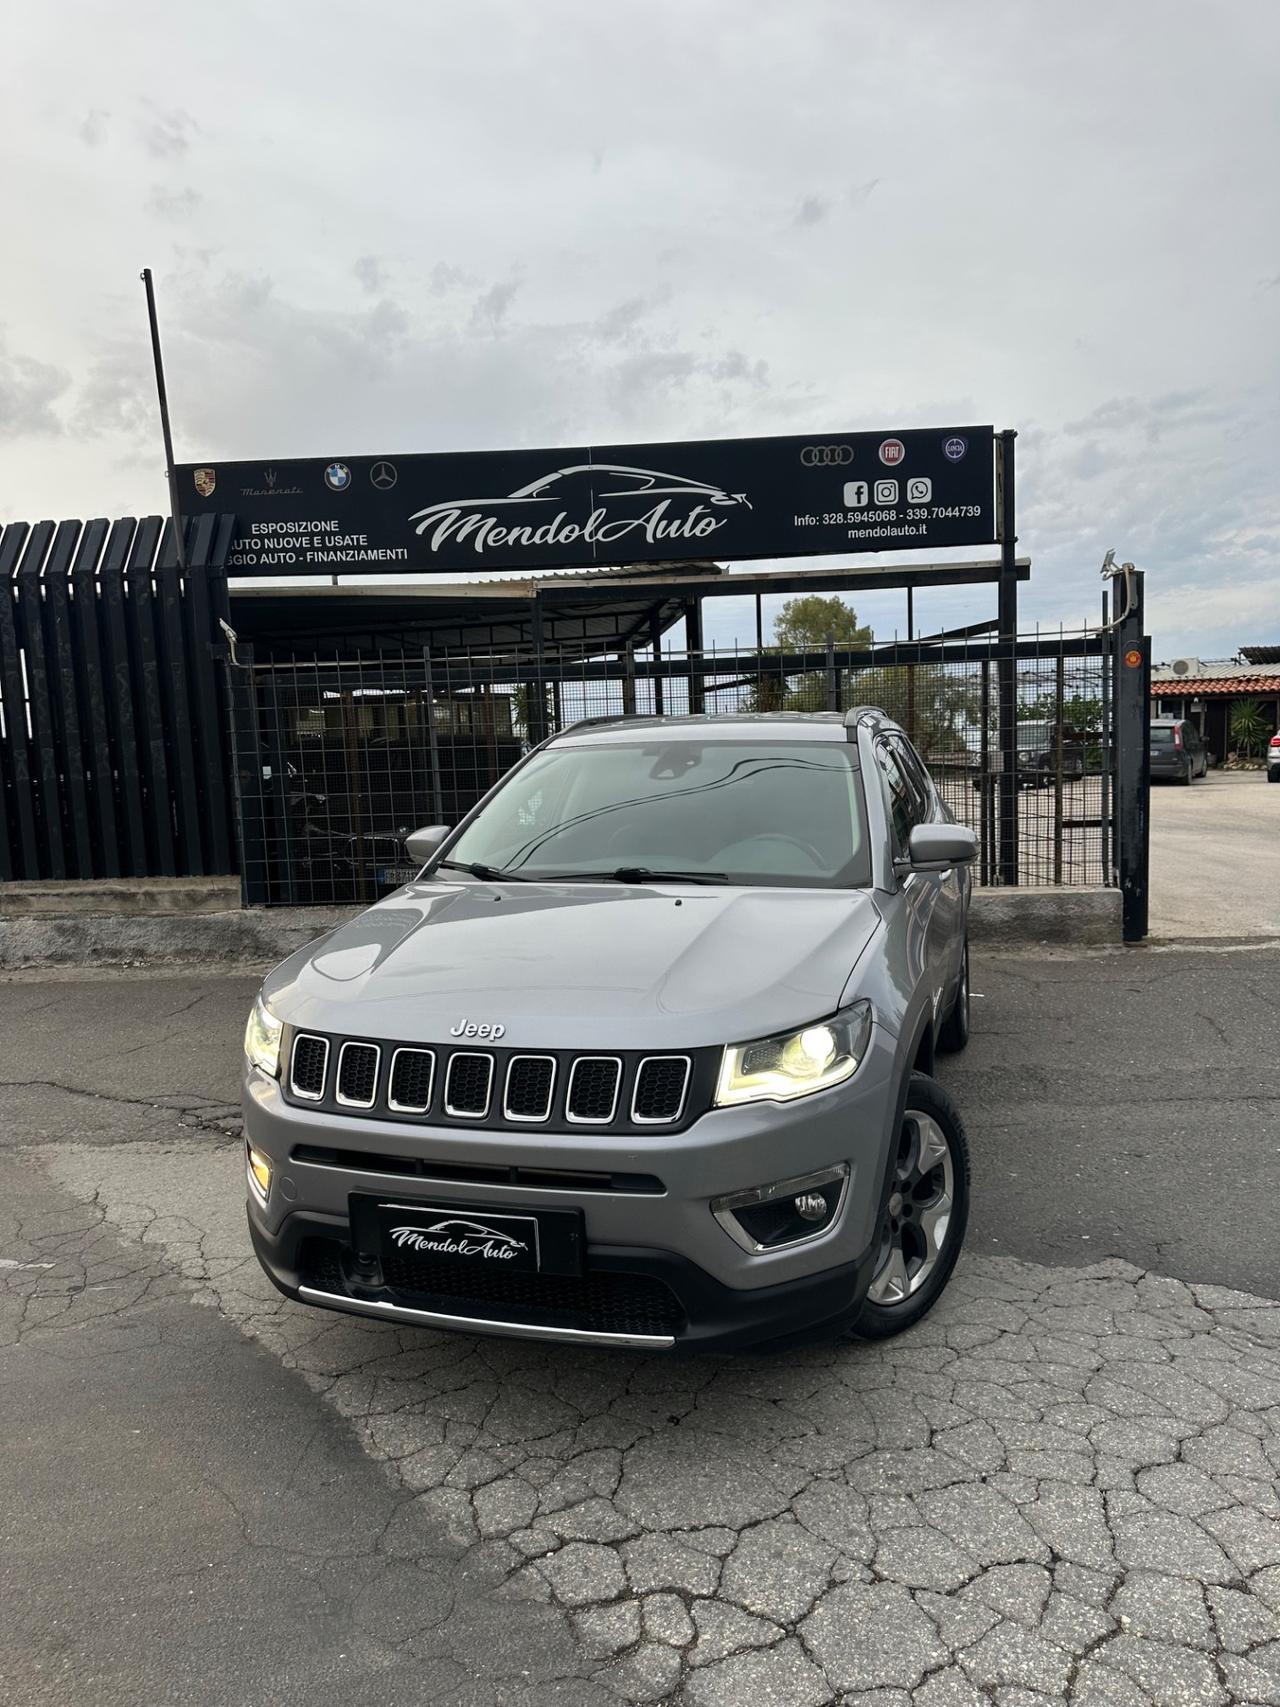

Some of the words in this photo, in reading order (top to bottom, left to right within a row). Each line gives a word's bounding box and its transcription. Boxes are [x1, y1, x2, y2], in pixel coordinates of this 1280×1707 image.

[885, 446, 899, 459] FIAT
[794, 513, 820, 526] Info:
[822, 510, 897, 525] 328.5945068
[906, 505, 981, 520] 339.7044739
[251, 520, 339, 535] ESPOSIZIONE
[848, 523, 927, 539] mendolauto.it
[264, 536, 311, 549] NUOVE
[313, 536, 323, 547] E
[325, 534, 368, 547] USATE
[260, 552, 296, 564] AUTO
[306, 548, 408, 563] FINANZIAMENTI
[450, 1019, 506, 1042] Jeep
